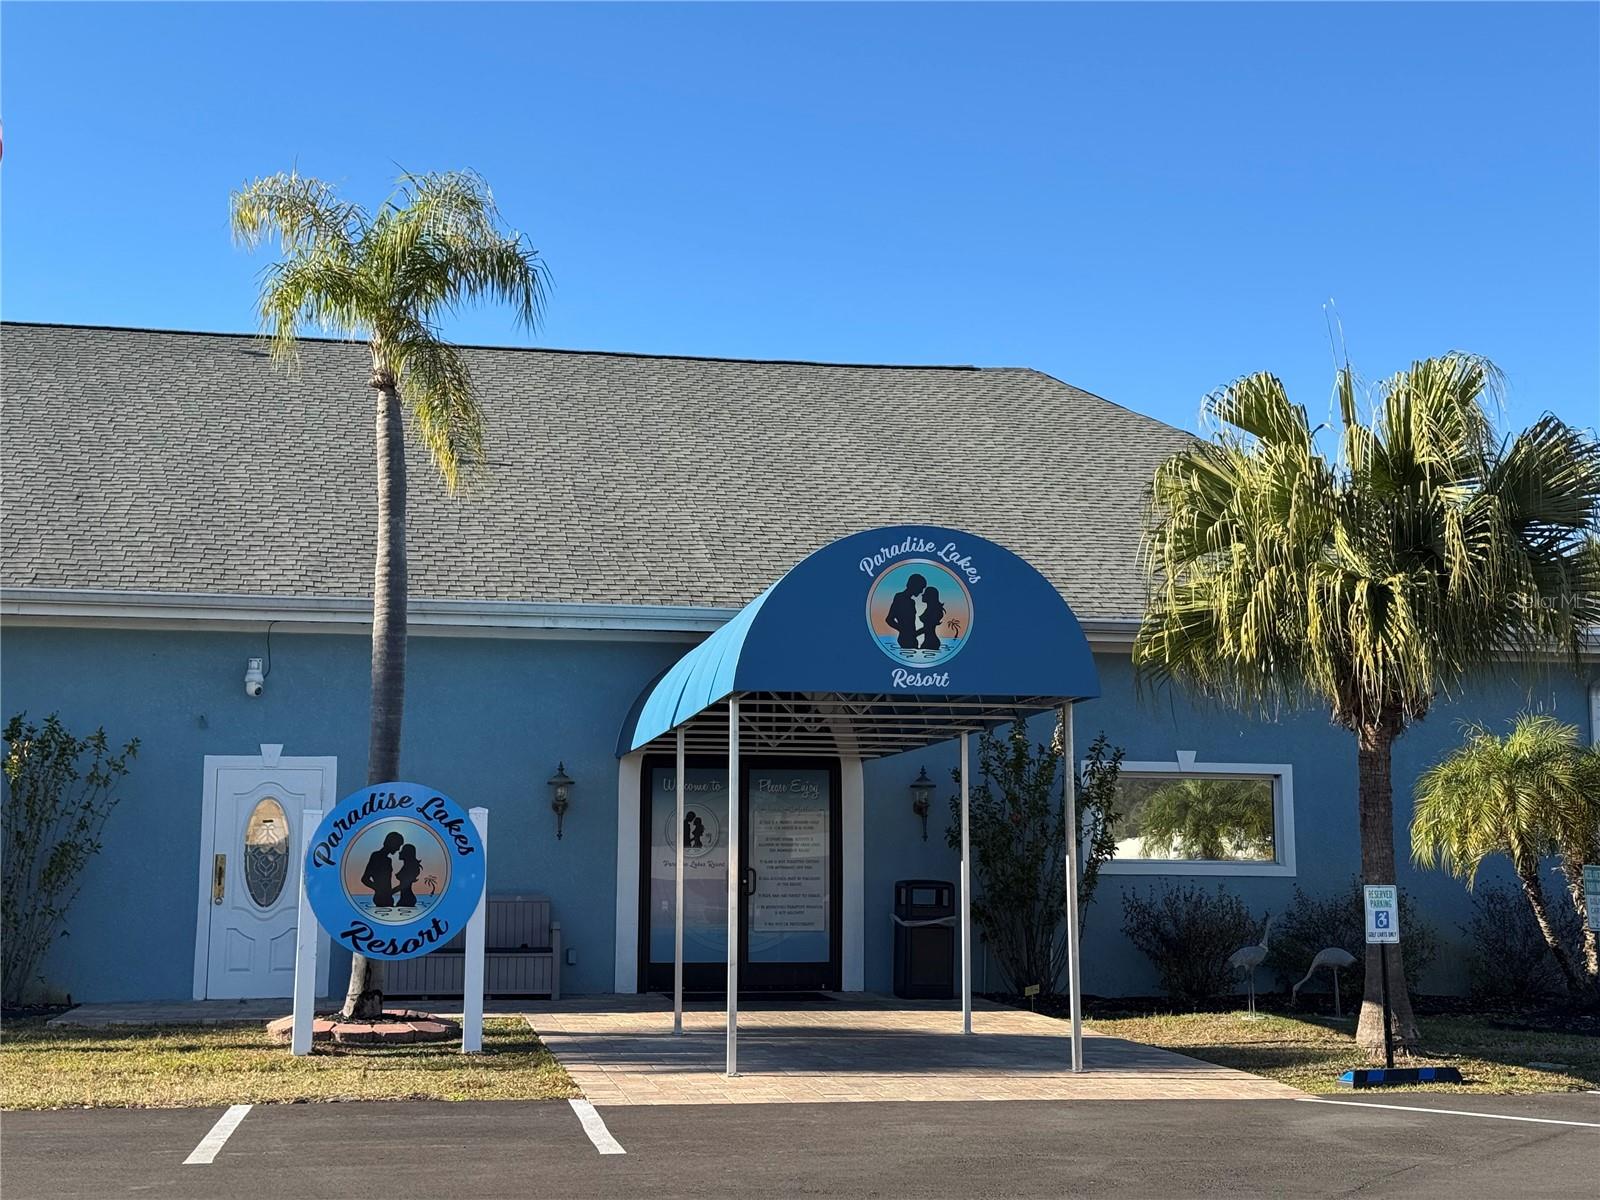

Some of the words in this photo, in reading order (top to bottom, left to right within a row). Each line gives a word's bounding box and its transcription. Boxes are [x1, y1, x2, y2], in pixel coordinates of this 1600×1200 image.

[859, 536, 937, 577] Paradise
[937, 542, 982, 584] Lakes
[891, 668, 950, 688] Resort
[663, 777, 708, 792] Wcome
[709, 780, 722, 791] to
[758, 778, 788, 793] Please
[789, 778, 820, 800] Enjoy
[312, 792, 415, 868] Paradise
[416, 796, 475, 856] Lakes
[1368, 889, 1393, 899] RESERVED
[1369, 899, 1393, 909] PARKING
[340, 917, 449, 956] Resort
